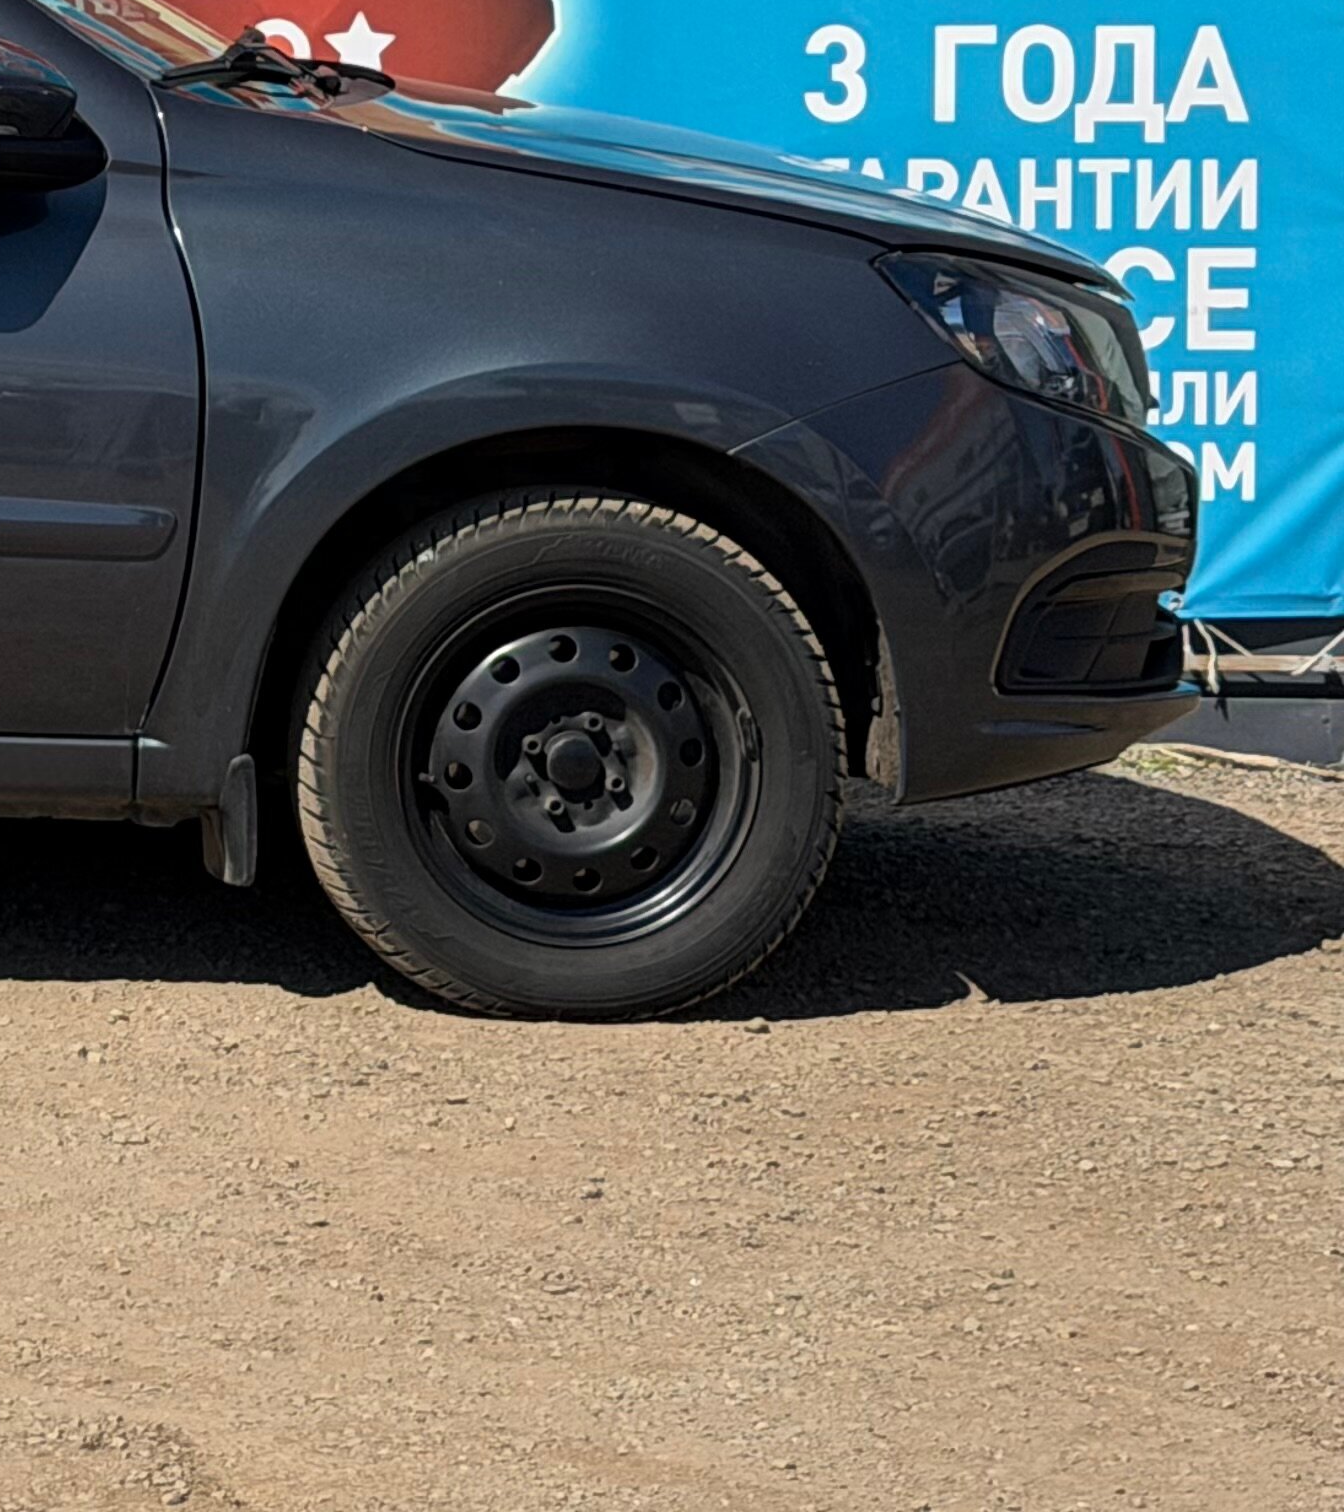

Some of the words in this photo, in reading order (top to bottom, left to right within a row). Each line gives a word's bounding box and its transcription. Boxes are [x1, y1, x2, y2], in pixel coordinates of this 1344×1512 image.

[804, 24, 867, 123] 3
[934, 24, 1249, 143] ГОДА
[820, 158, 1258, 231] РАНТИИ
